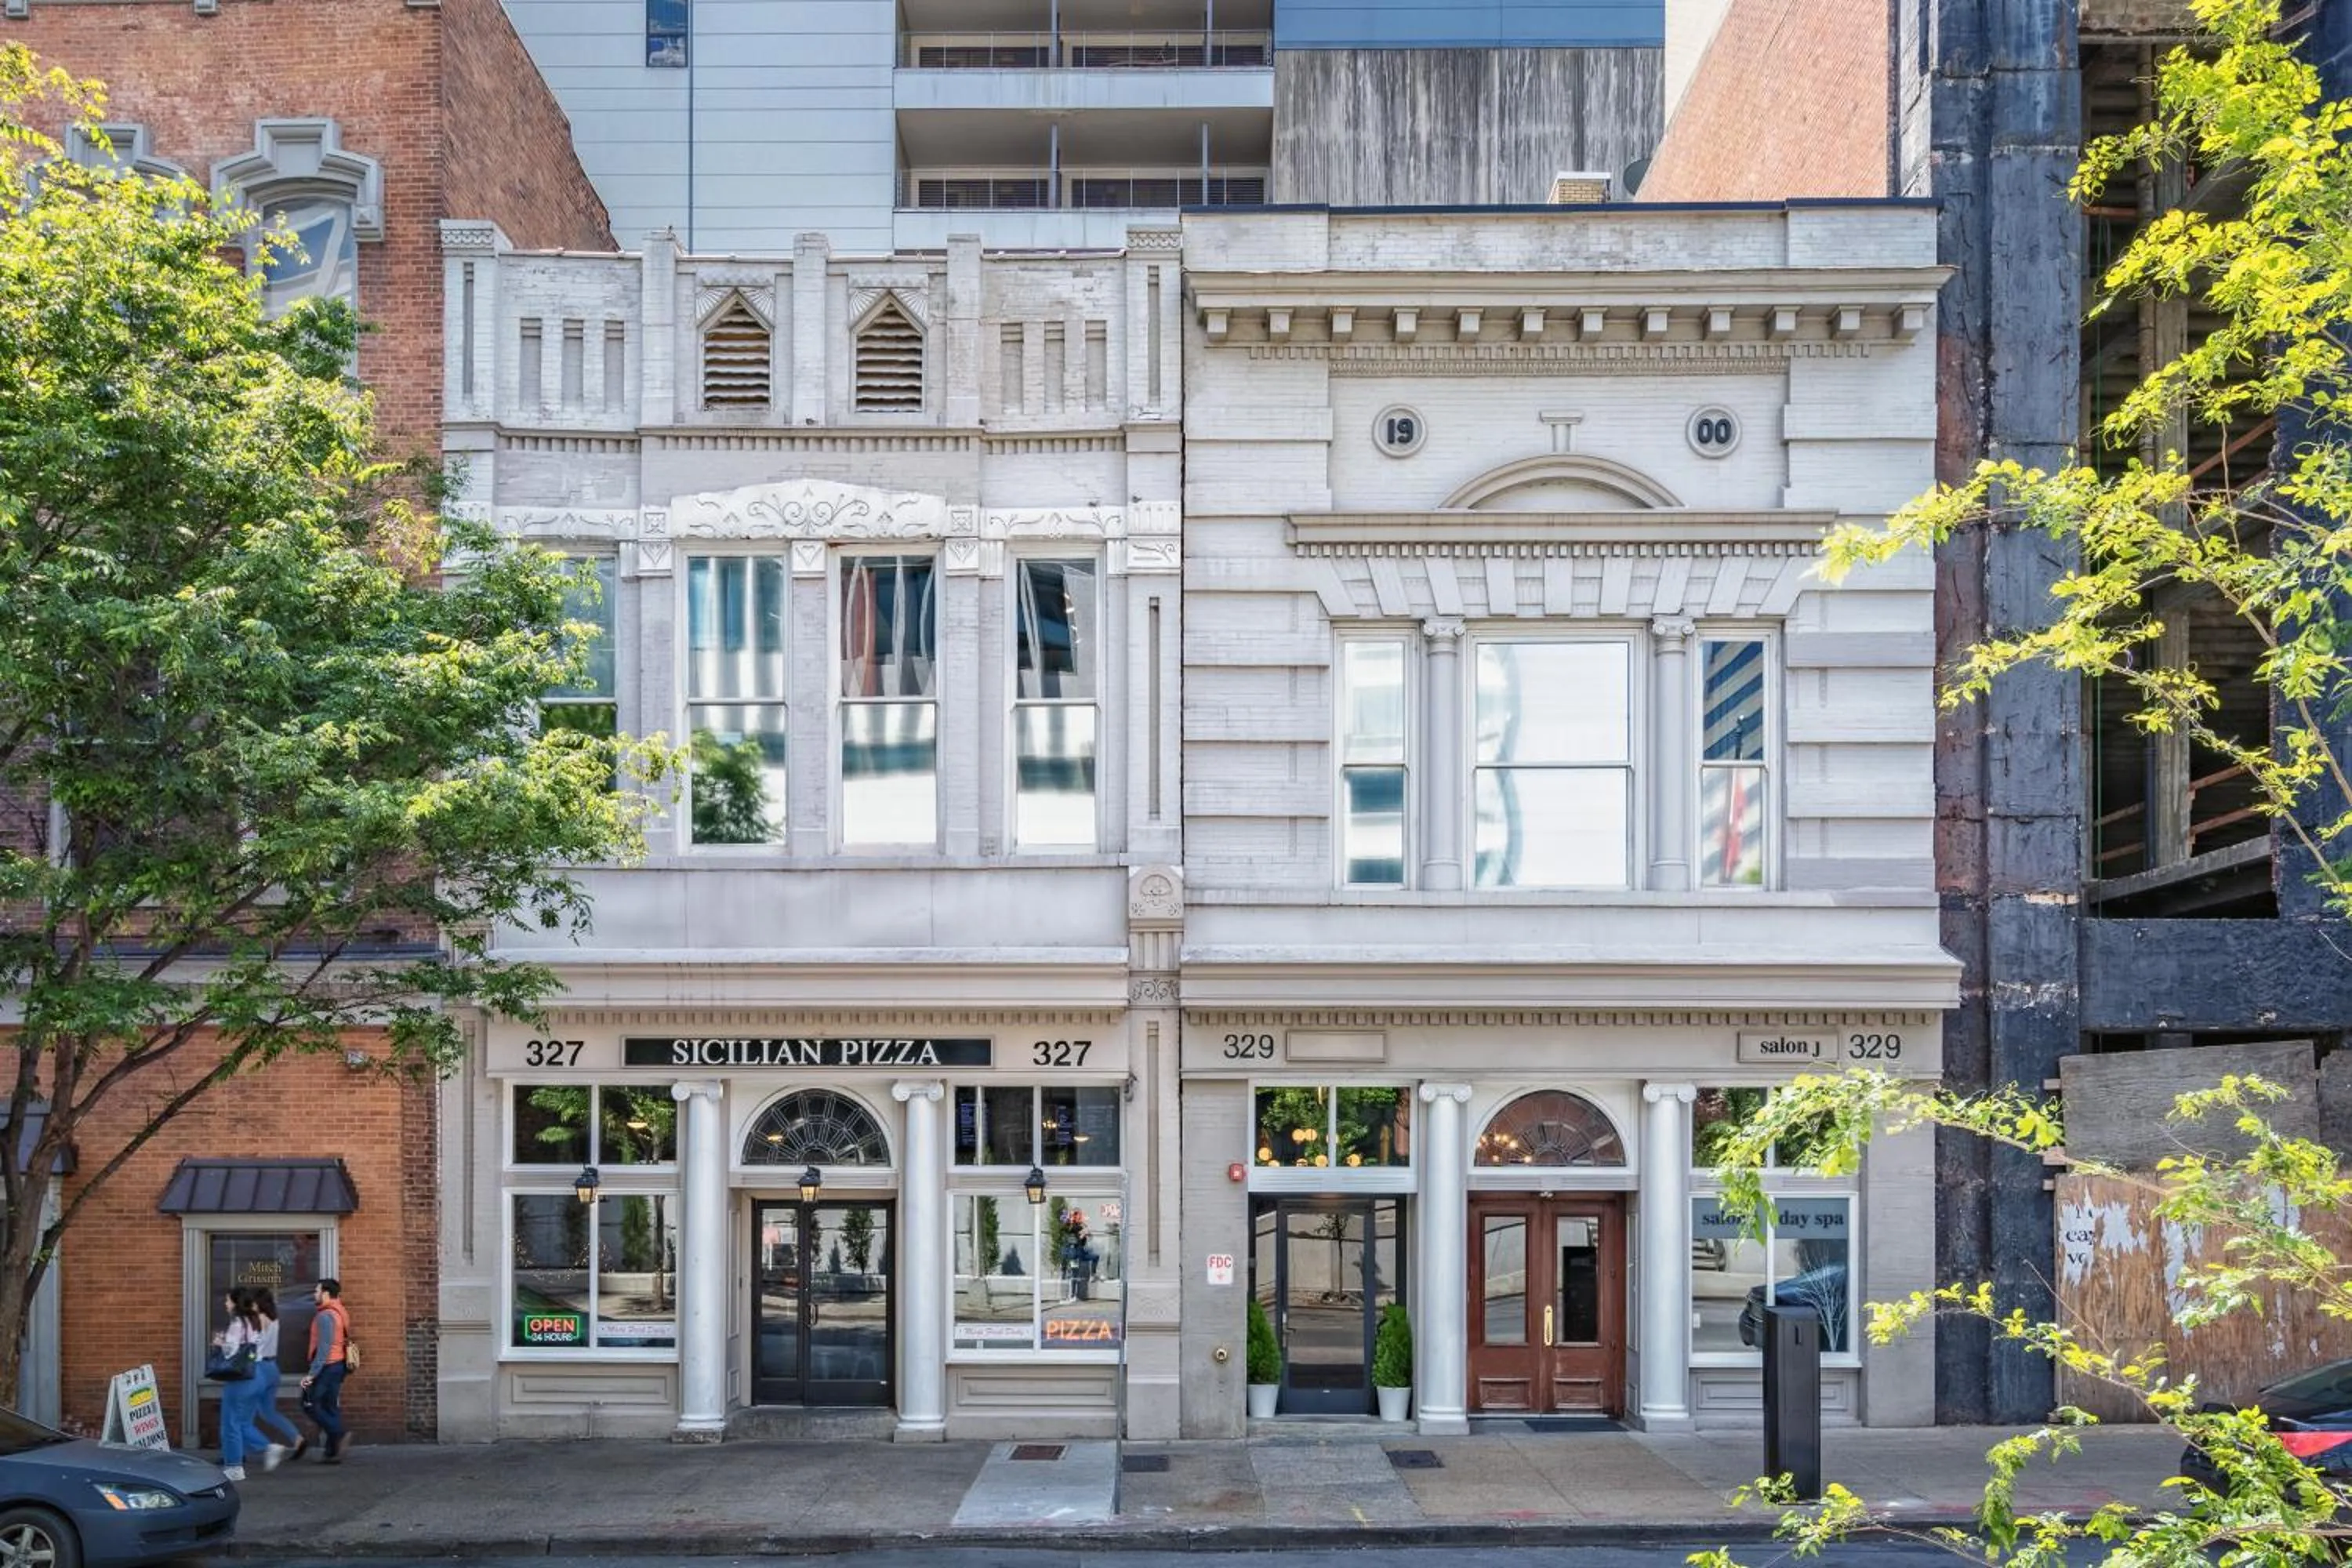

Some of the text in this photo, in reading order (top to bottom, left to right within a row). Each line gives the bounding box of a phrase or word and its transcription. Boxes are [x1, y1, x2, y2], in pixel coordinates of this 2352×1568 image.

[1387, 418, 1414, 445] 19
[1697, 418, 1732, 445] 00
[525, 1040, 585, 1067] 327
[672, 1039, 942, 1065] SICILIAN PIZZA
[1032, 1040, 1092, 1067] 327
[1223, 1033, 1275, 1059] 329
[1759, 1036, 1820, 1058] salon j
[1849, 1033, 1901, 1059] 329
[1780, 1210, 1809, 1229] day
[1813, 1214, 1845, 1229] spa
[1209, 1256, 1232, 1268] FDC
[529, 1318, 575, 1332] OPEN
[544, 1333, 573, 1342] HOURS
[1046, 1319, 1112, 1340] PIZZA
